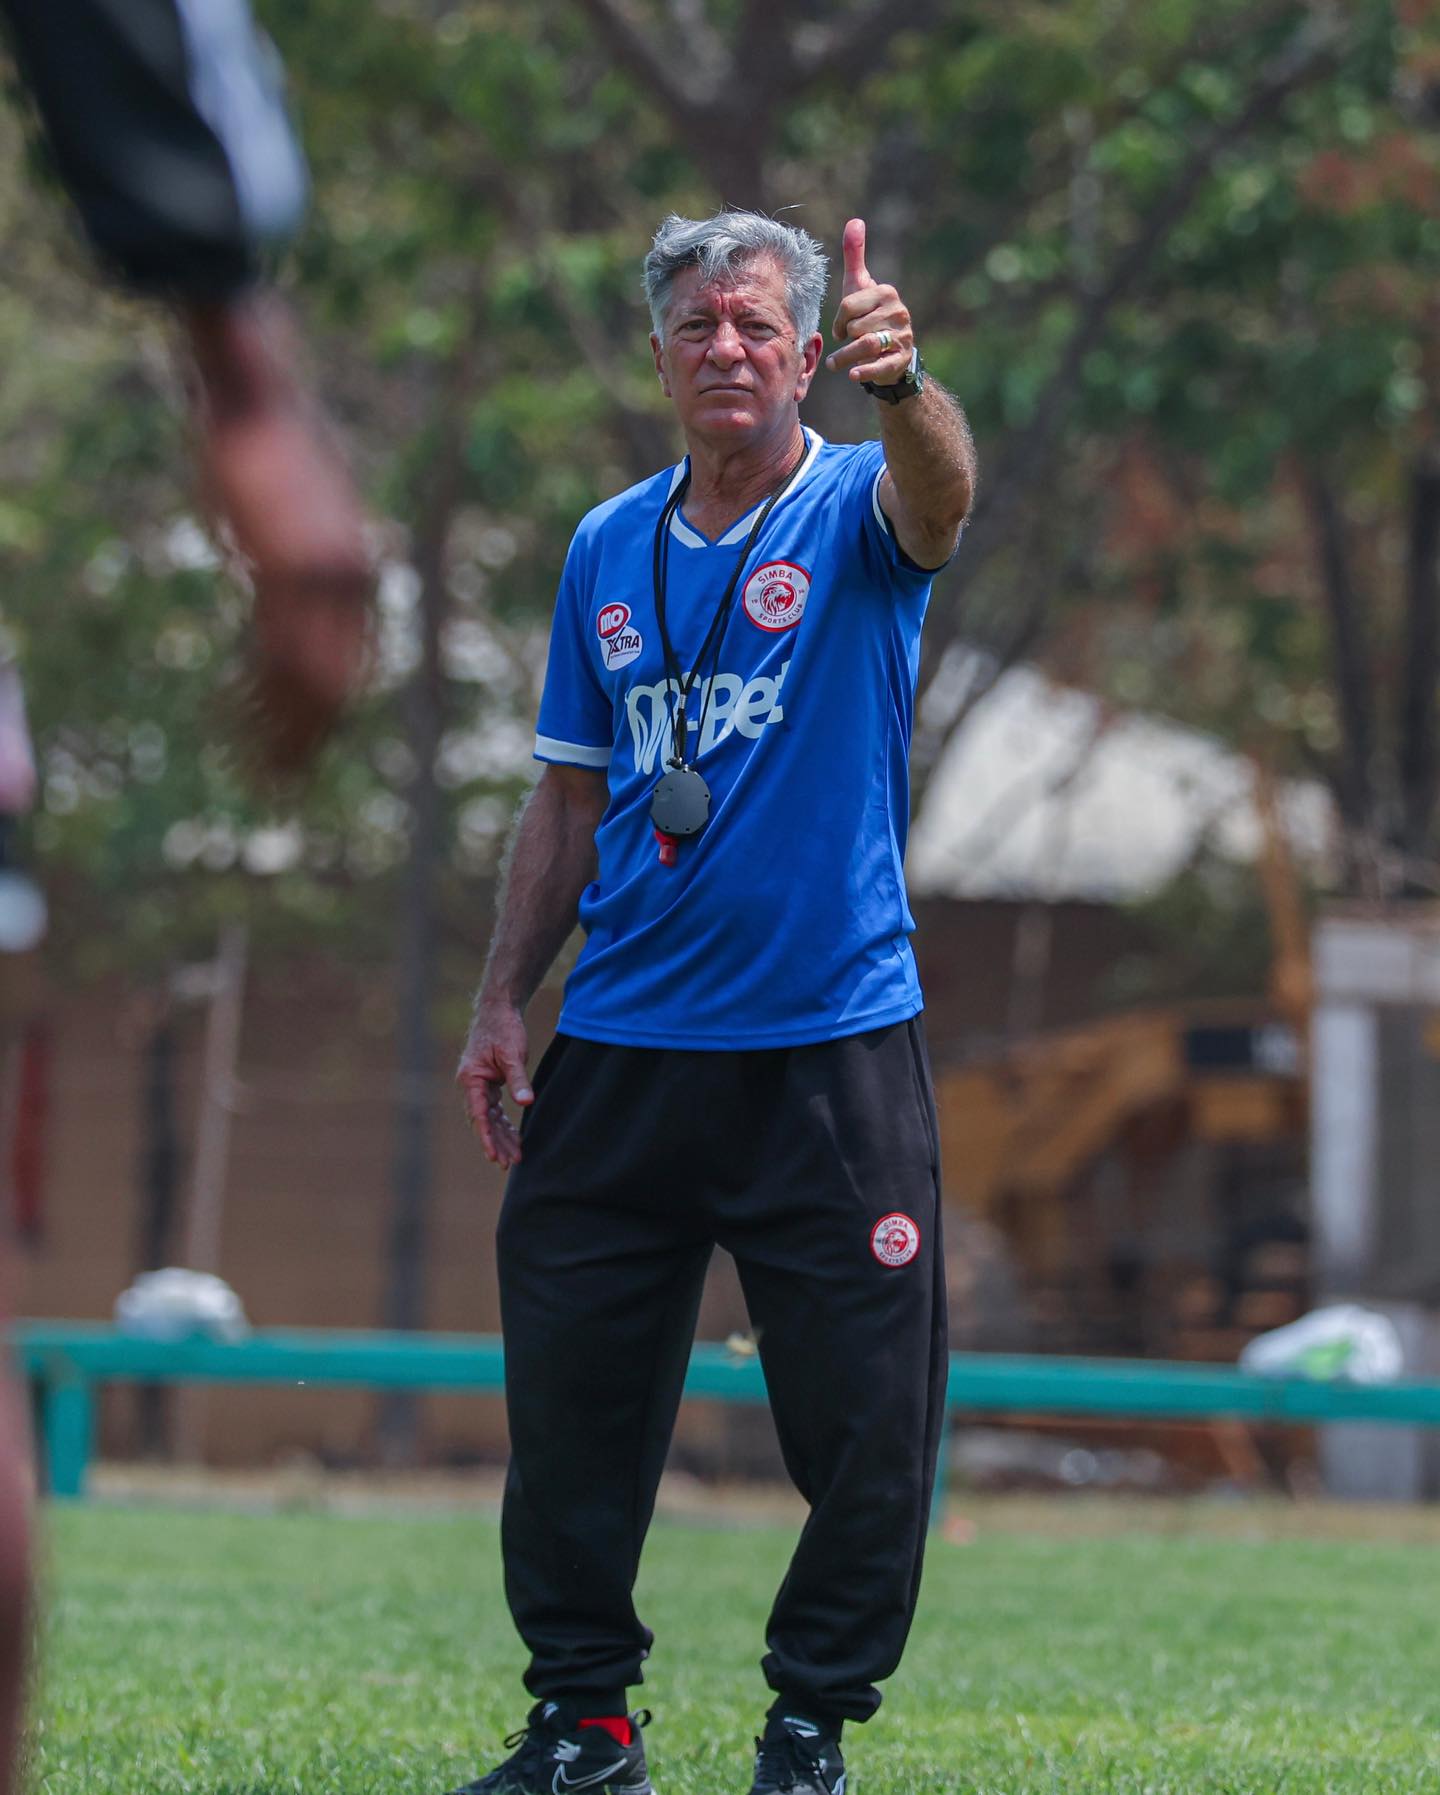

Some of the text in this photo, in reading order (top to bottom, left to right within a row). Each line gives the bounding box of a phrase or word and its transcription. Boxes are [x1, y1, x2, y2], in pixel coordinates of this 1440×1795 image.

[758, 569, 793, 584] SIMBA
[759, 604, 803, 624] SPORTS CLUB
[606, 632, 640, 659] XTRA
